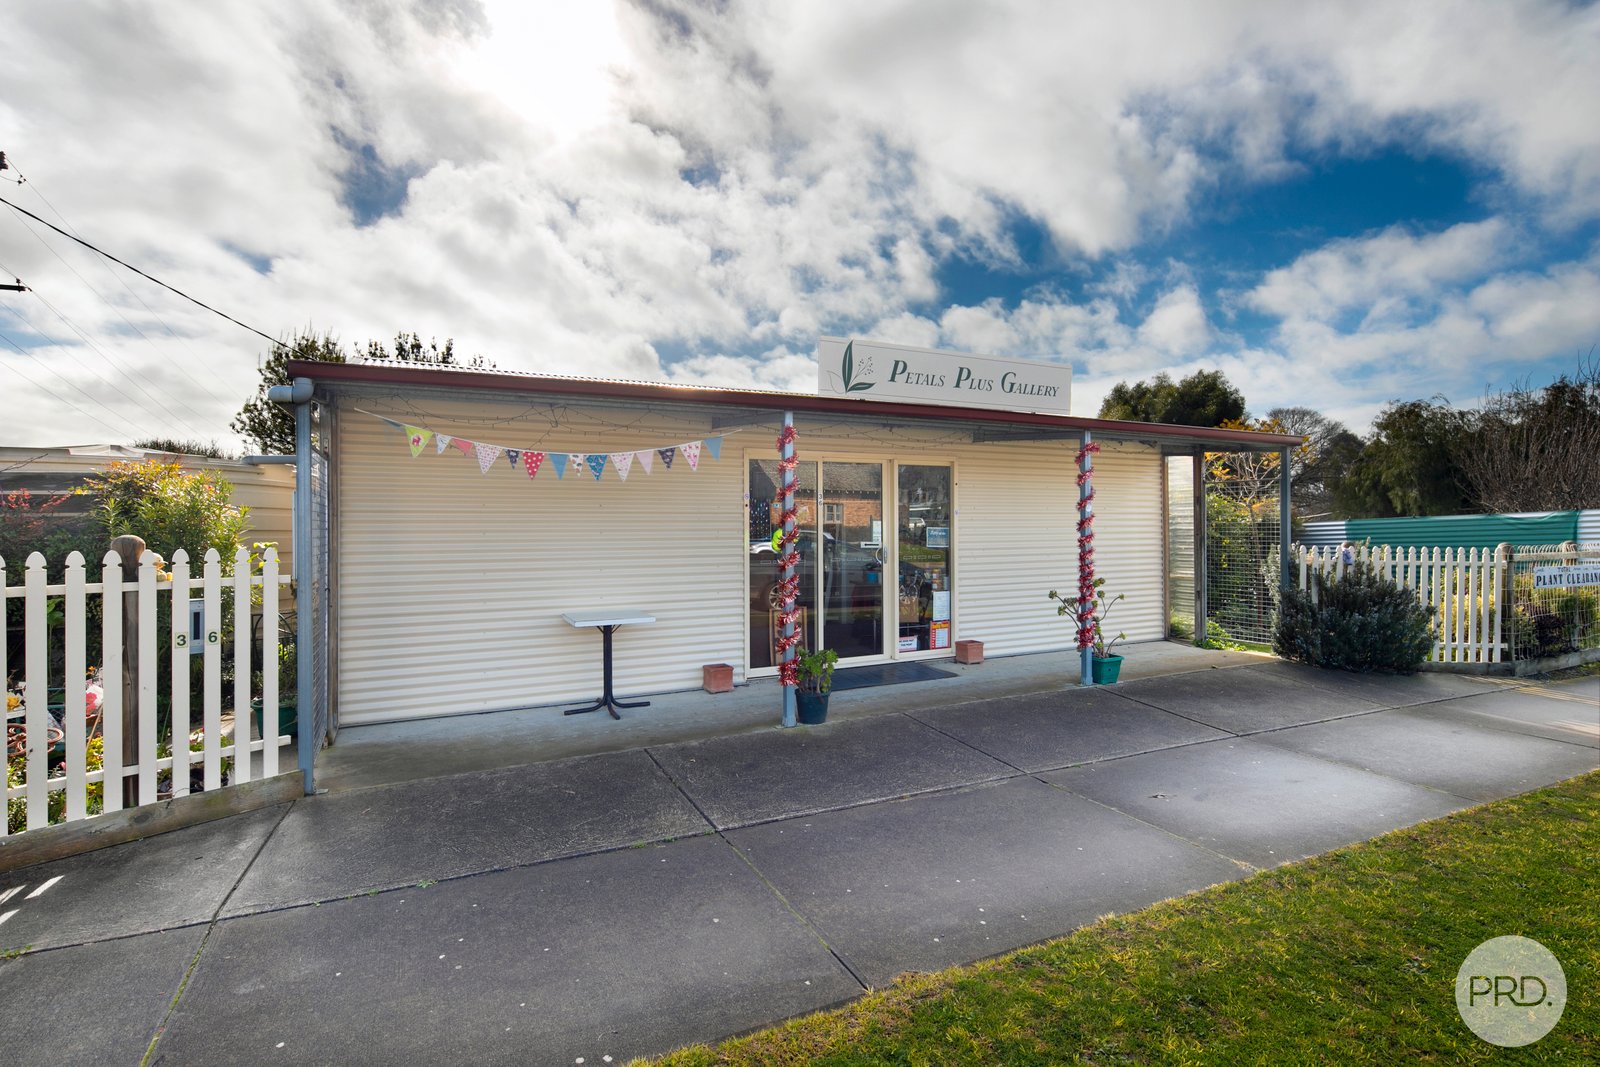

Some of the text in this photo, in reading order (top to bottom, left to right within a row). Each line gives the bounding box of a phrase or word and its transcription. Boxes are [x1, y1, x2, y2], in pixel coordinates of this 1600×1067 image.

[953, 366, 994, 392] PLUS
[1001, 371, 1060, 397] GALLERY
[1536, 574, 1563, 587] PLANT
